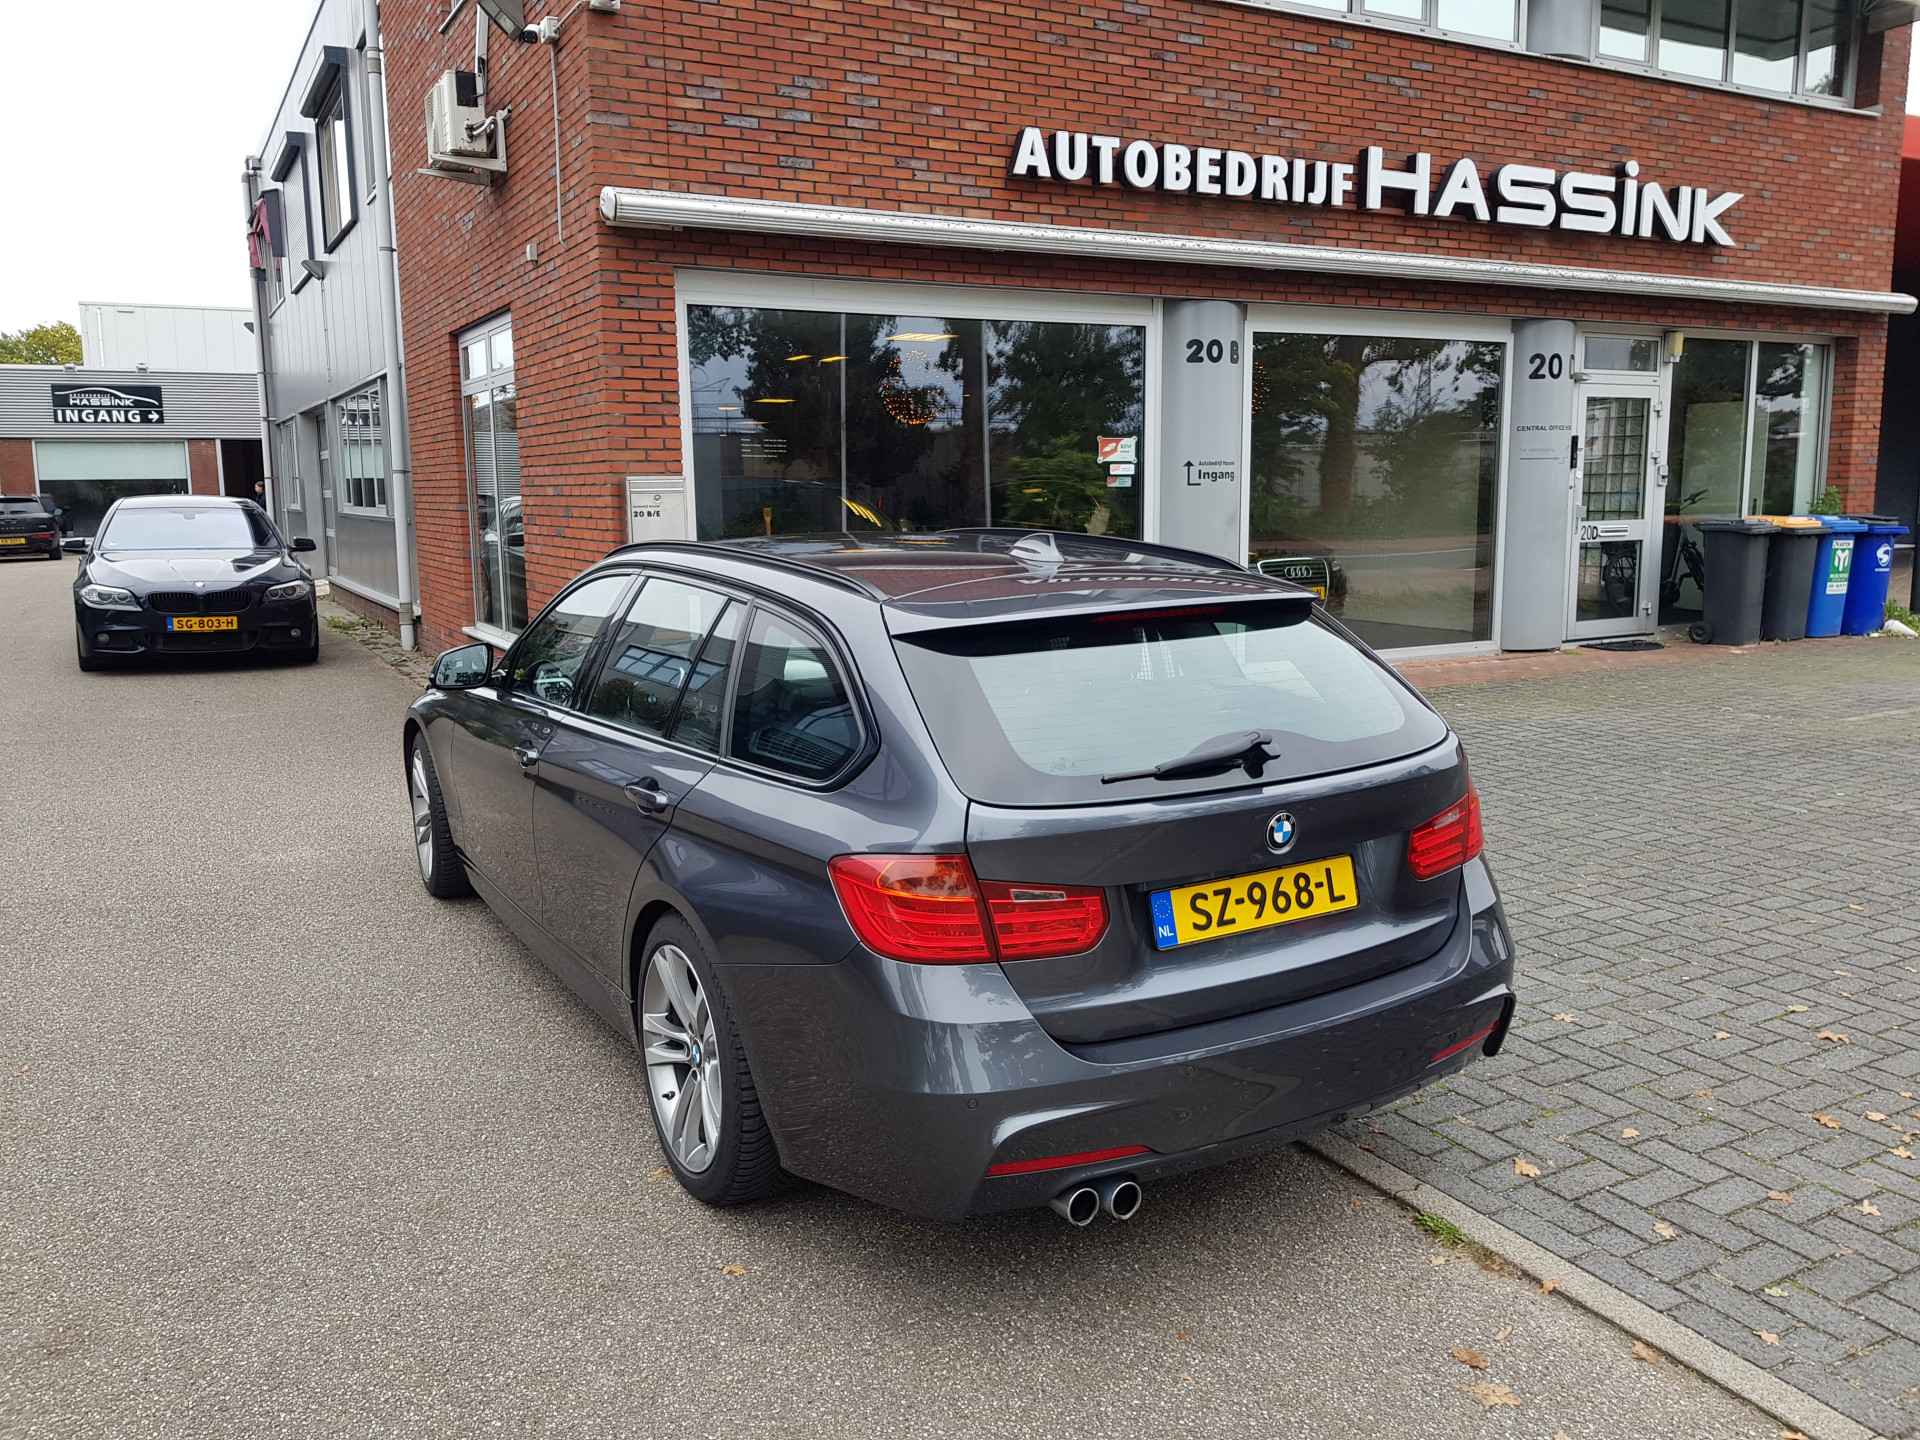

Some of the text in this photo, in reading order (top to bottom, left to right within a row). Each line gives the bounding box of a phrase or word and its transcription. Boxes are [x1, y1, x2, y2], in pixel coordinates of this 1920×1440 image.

[1012, 126, 1355, 206] AUTOBEDRIJF
[1186, 338, 1240, 365] 20 B
[1528, 353, 1563, 380] 20
[56, 409, 141, 423] INGANG
[1516, 424, 1547, 432] CENTRAL
[1198, 469, 1235, 482] Ingang
[633, 510, 645, 518] 20
[1580, 524, 1599, 541] 20D
[176, 618, 234, 629] SG-803-H
[1189, 867, 1346, 931] SZ-968-L
[1158, 924, 1174, 938] NL
